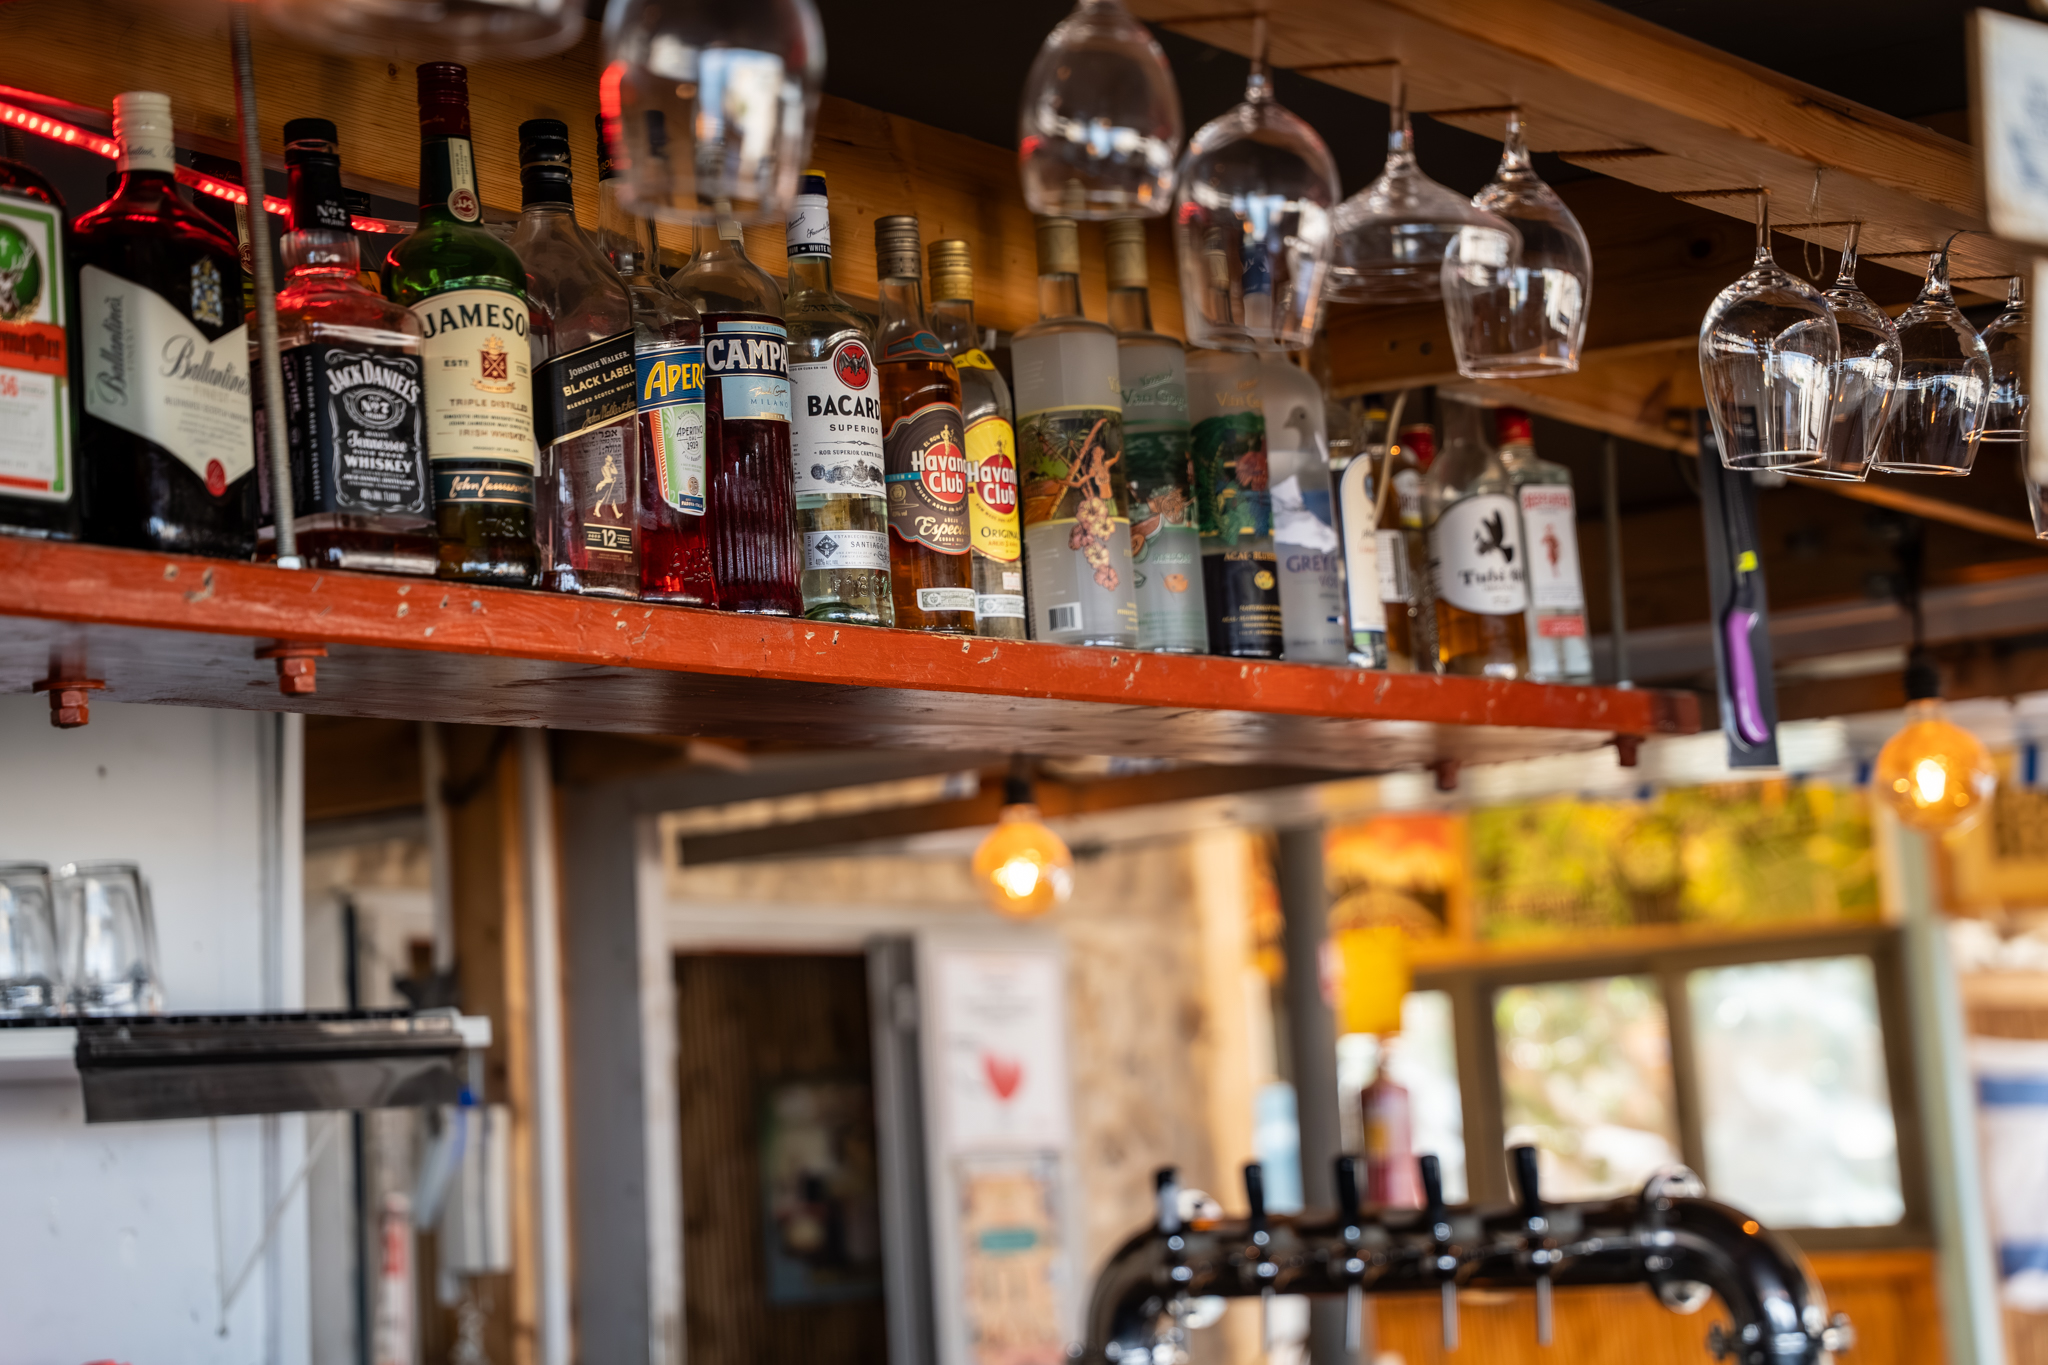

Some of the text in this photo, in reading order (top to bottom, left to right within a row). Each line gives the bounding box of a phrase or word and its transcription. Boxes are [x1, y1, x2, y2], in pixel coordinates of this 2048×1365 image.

[809, 244, 827, 253] WHITE
[159, 334, 251, 396] Ballantine's
[568, 361, 600, 380] JOHNNIE
[325, 360, 421, 403] JACK DANIEL'S
[562, 363, 636, 397] BLACK LABEL
[449, 399, 487, 407] TRIPLE
[566, 381, 636, 410] BLENDED SCOTCH WHISKY
[751, 398, 789, 408] MILANO
[459, 429, 526, 441] IRISH WHISKEY
[829, 424, 879, 435] SUPERIOR
[346, 429, 408, 453] Tennessee
[923, 434, 940, 448] EL RON
[343, 454, 413, 473] WHISKEY
[449, 475, 480, 498] John
[929, 472, 964, 494] Club
[915, 482, 931, 503] DOUBLE
[932, 502, 947, 511] AGED
[983, 482, 1016, 505] Club
[601, 529, 617, 547] 12
[850, 541, 884, 549] SANTIAGO
[1286, 554, 1328, 573] GREY
